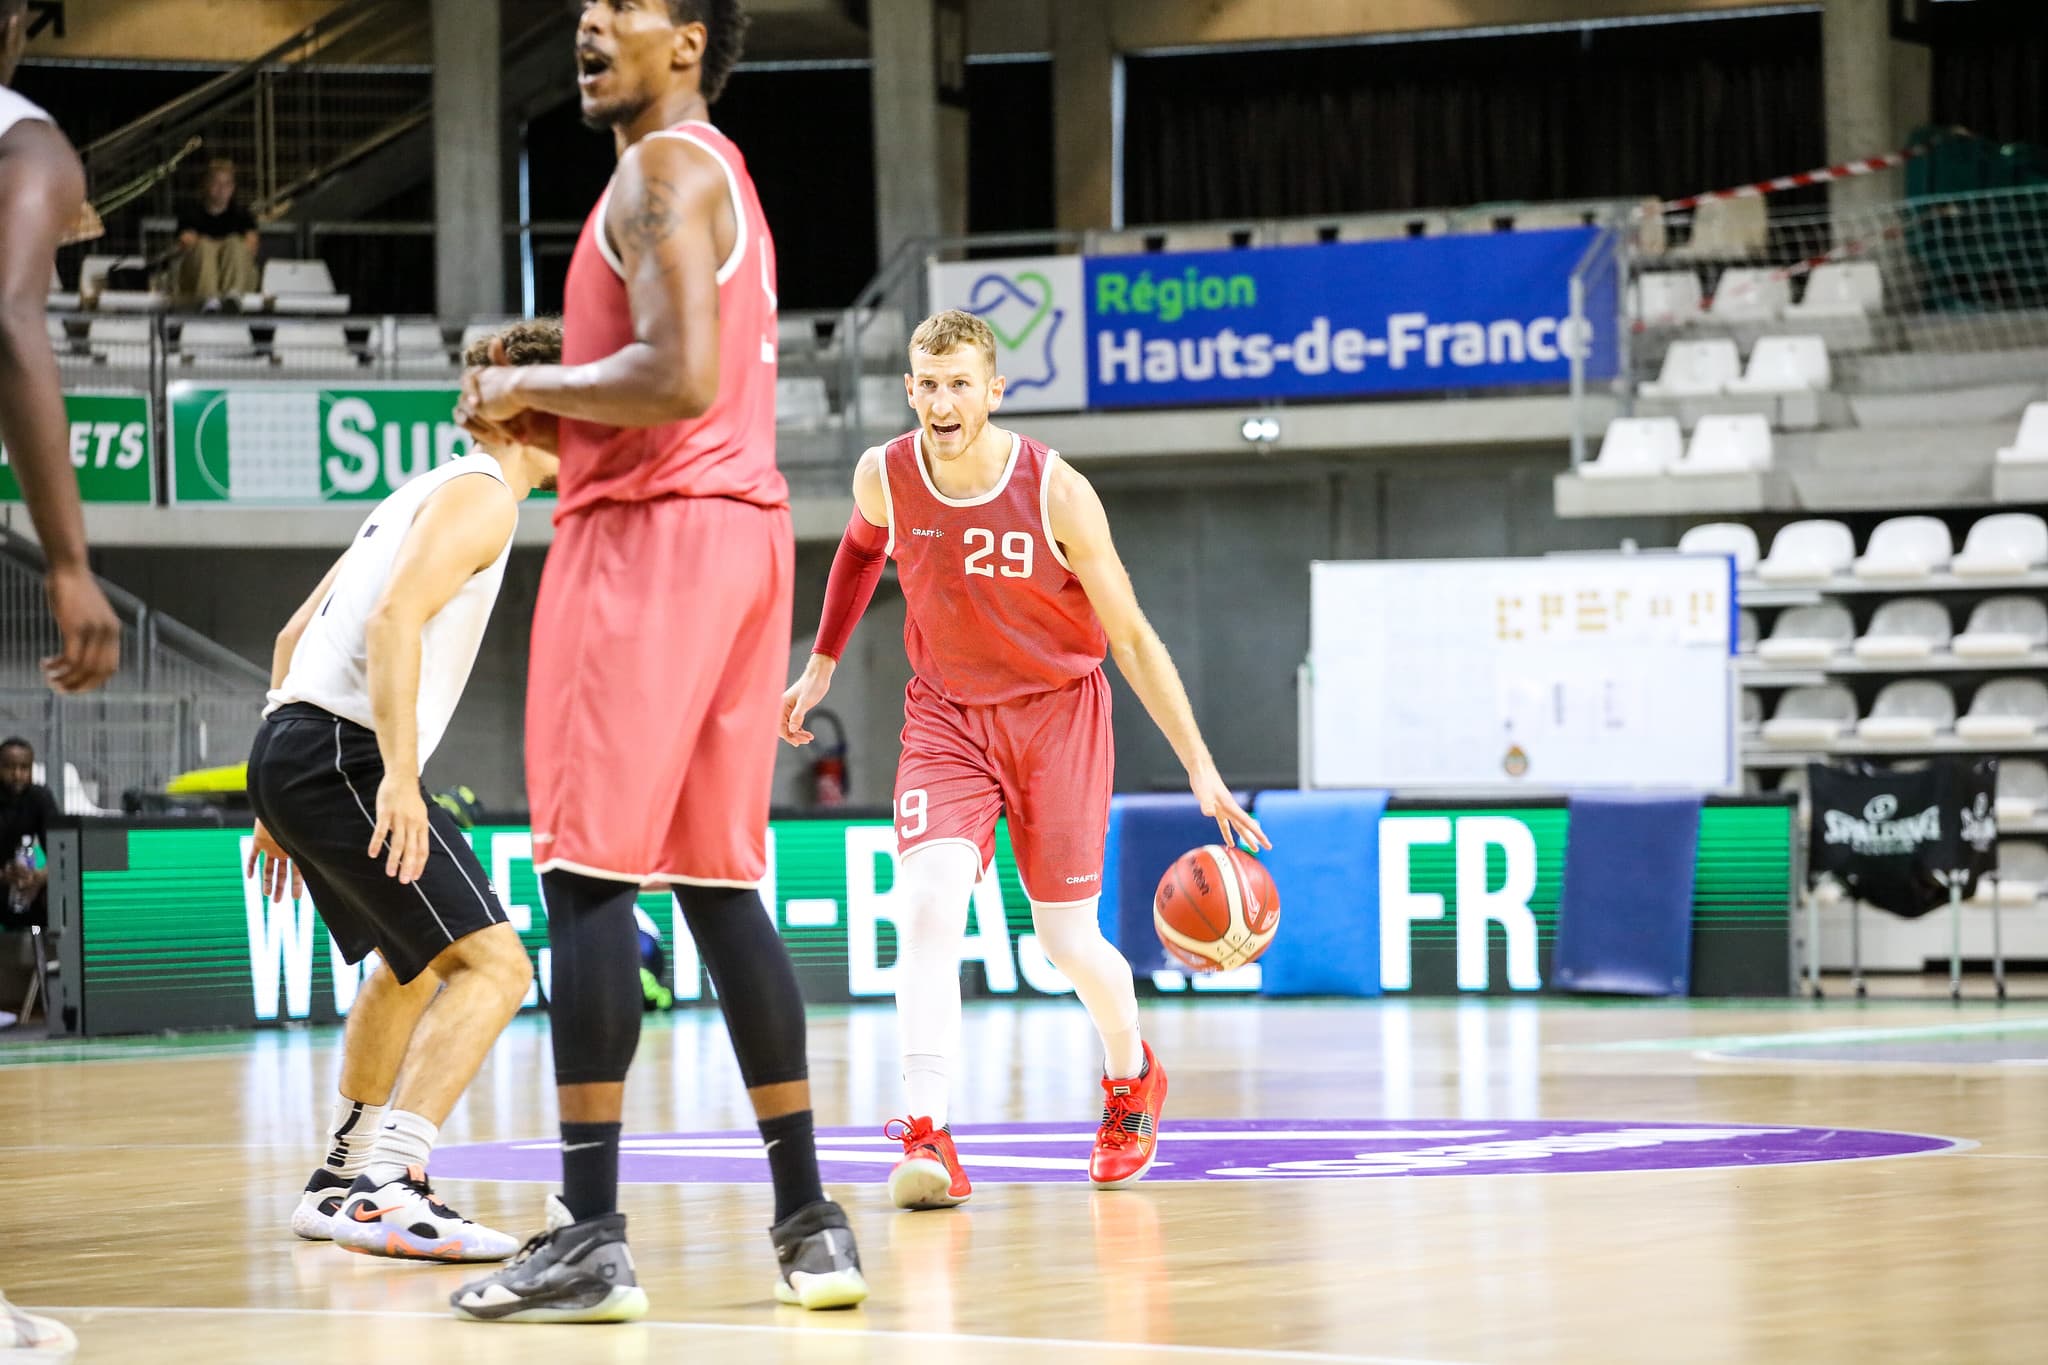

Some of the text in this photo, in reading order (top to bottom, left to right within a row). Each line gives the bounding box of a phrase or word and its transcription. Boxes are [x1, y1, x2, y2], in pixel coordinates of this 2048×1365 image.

[1097, 266, 1256, 322] Région
[1097, 312, 1594, 385] Hauts-de-France
[68, 420, 146, 470] ETS
[912, 527, 935, 537] CRAFT
[963, 527, 1034, 579] 29
[893, 788, 928, 839] 9
[1065, 874, 1094, 885] CRAFT
